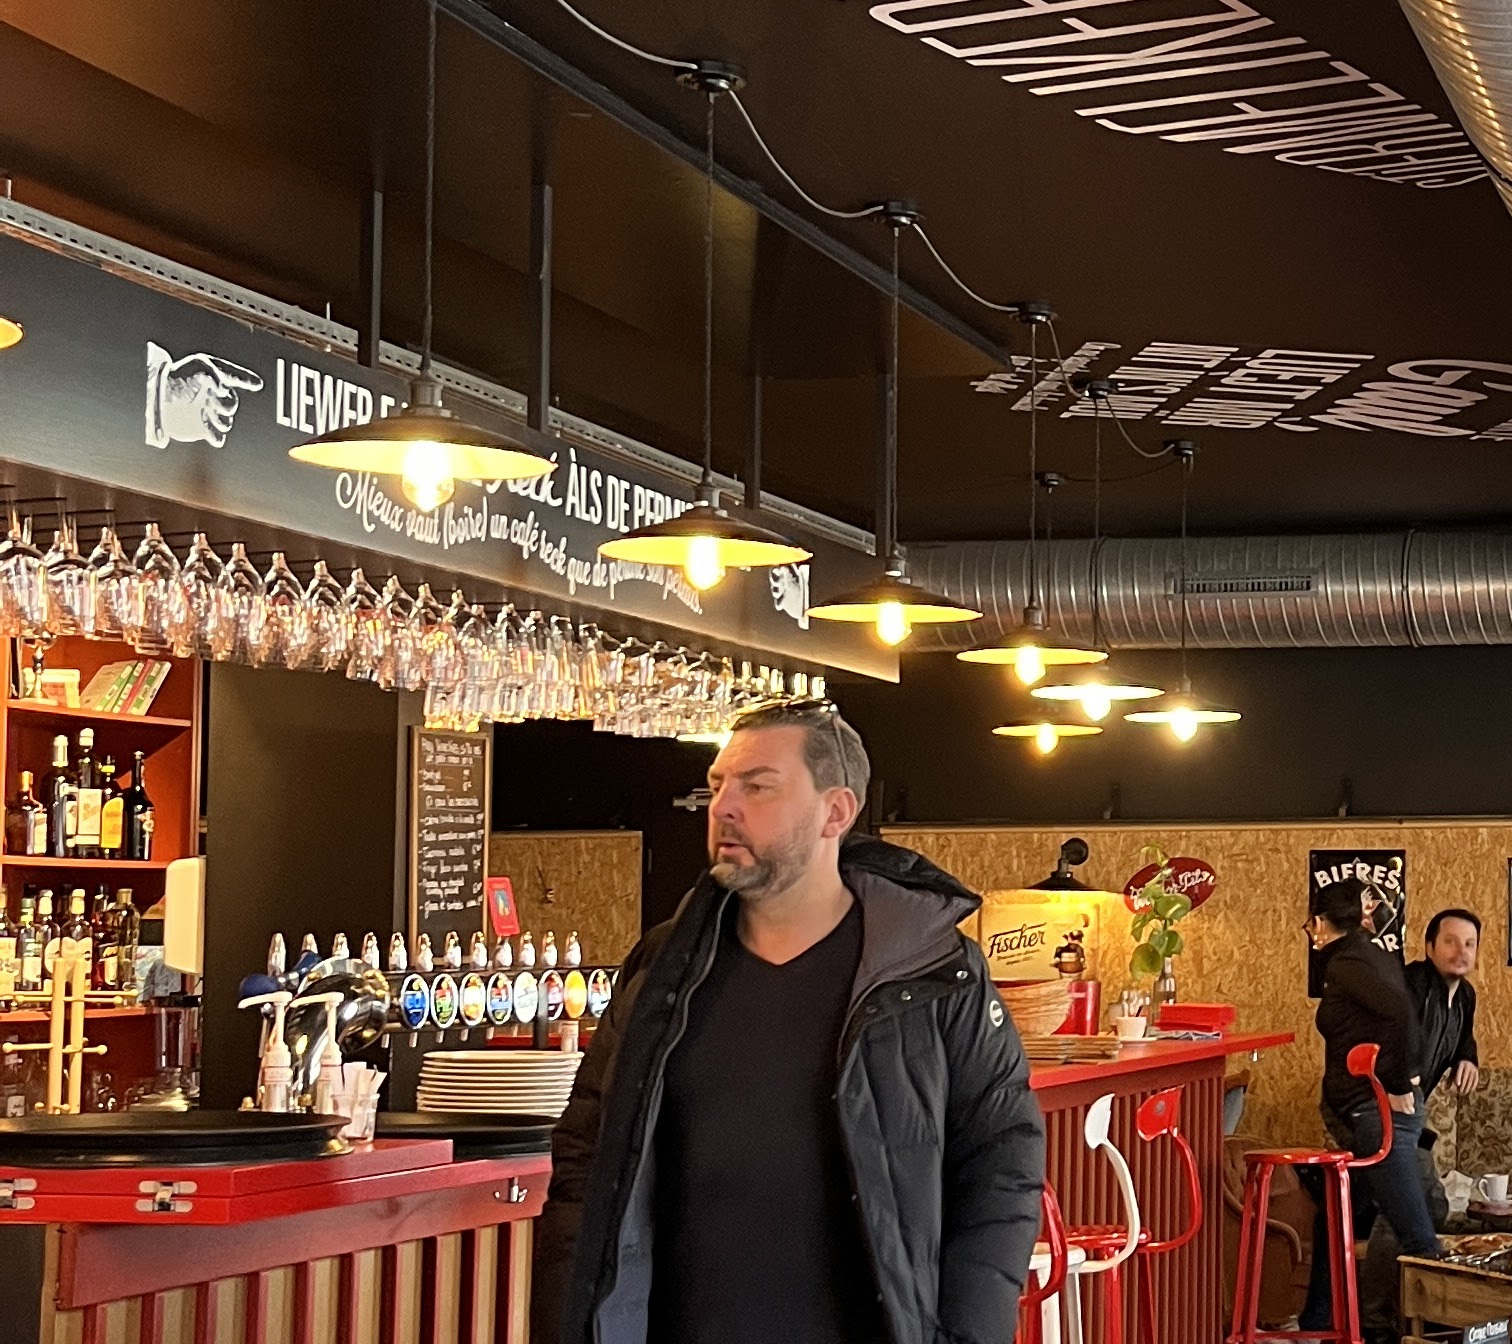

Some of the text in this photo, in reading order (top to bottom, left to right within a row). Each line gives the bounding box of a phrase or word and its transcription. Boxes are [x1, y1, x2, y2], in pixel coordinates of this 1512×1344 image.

[335, 471, 404, 533] Mieux
[404, 506, 442, 545] vaut
[442, 495, 489, 550] (boire)
[489, 513, 510, 540] un
[509, 510, 540, 560] café
[566, 556, 592, 595] que
[591, 552, 609, 588] de
[565, 448, 603, 525] ÀLS
[606, 475, 631, 533] DE
[988, 922, 1047, 959] Fischer
